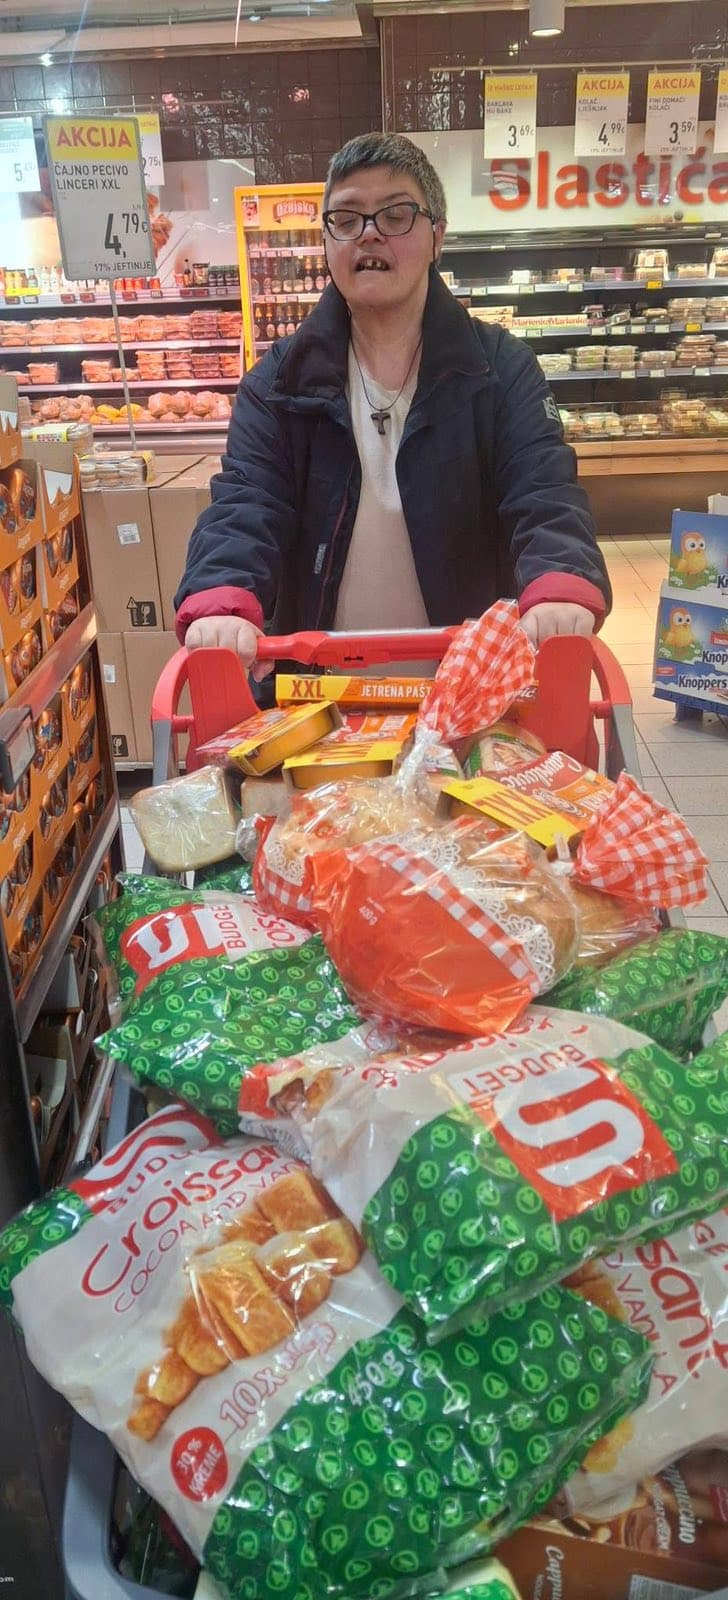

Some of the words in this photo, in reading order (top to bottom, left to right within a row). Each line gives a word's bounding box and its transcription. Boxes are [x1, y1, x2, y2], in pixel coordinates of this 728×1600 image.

[583, 78, 625, 90] AKCIJA
[653, 78, 696, 90] AKCIJA
[56, 126, 132, 148] AKCIJA
[54, 162, 90, 176] ČAJNO
[92, 164, 129, 176] PECIVO
[56, 179, 98, 190] LINCERI
[101, 179, 121, 190] XXL
[112, 261, 152, 272] JEFTINIJE
[290, 679, 325, 699] XXL
[361, 684, 405, 698] JETRENA
[678, 675, 727, 691] Knoppers
[461, 1044, 587, 1098] BUDGET
[114, 1216, 198, 1314] COCOA
[188, 1443, 222, 1496] KREME
